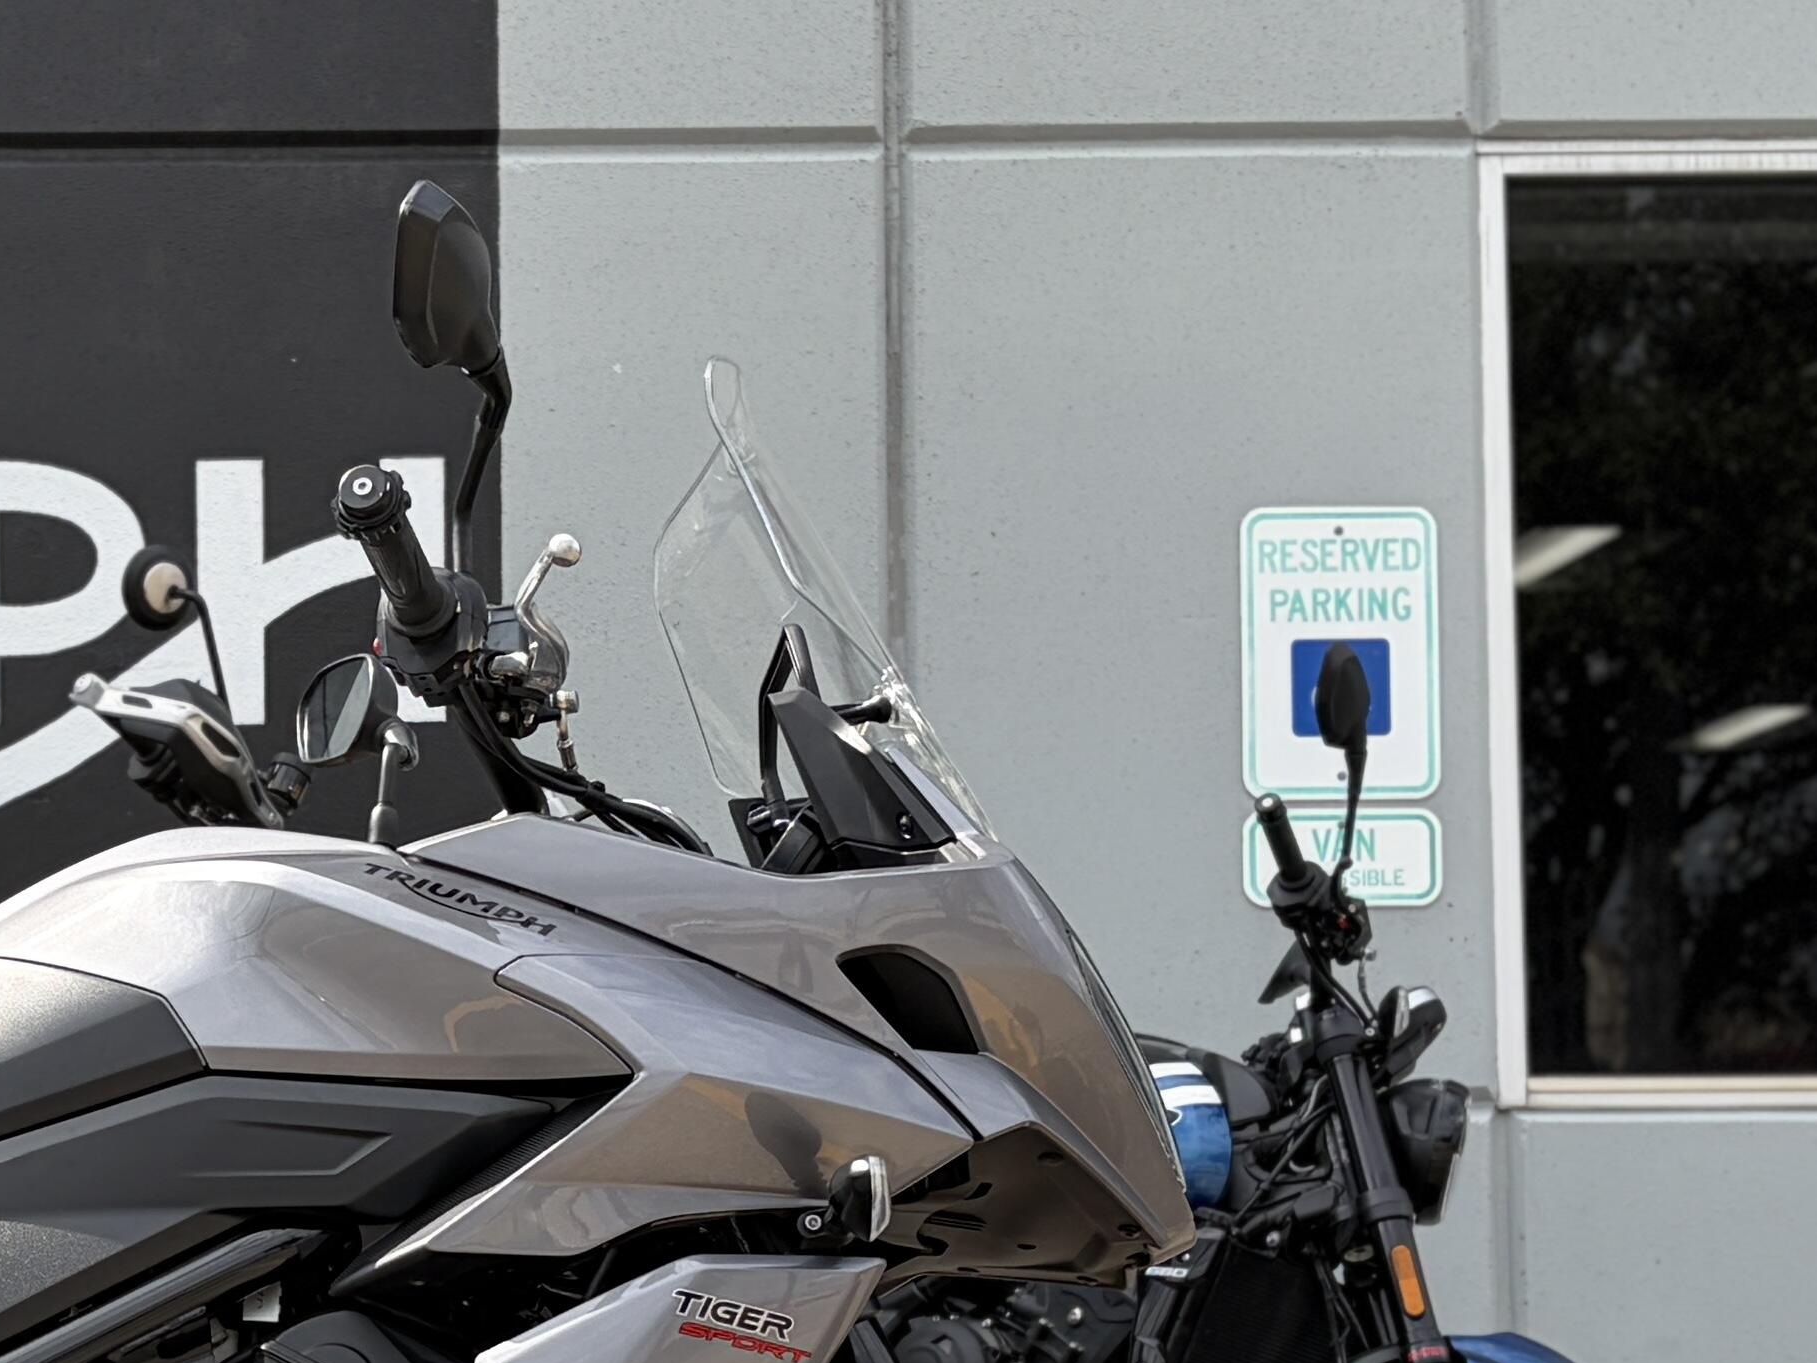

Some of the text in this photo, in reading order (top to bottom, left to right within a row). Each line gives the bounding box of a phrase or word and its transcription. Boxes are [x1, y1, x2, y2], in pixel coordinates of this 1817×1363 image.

[1258, 537, 1423, 574] RESERVED
[1269, 587, 1413, 623] PARKING
[1341, 868, 1406, 887] SIBLE
[363, 863, 558, 938] TRIUMPH
[672, 1288, 795, 1343] TIGER
[678, 1321, 813, 1363] SPORT
